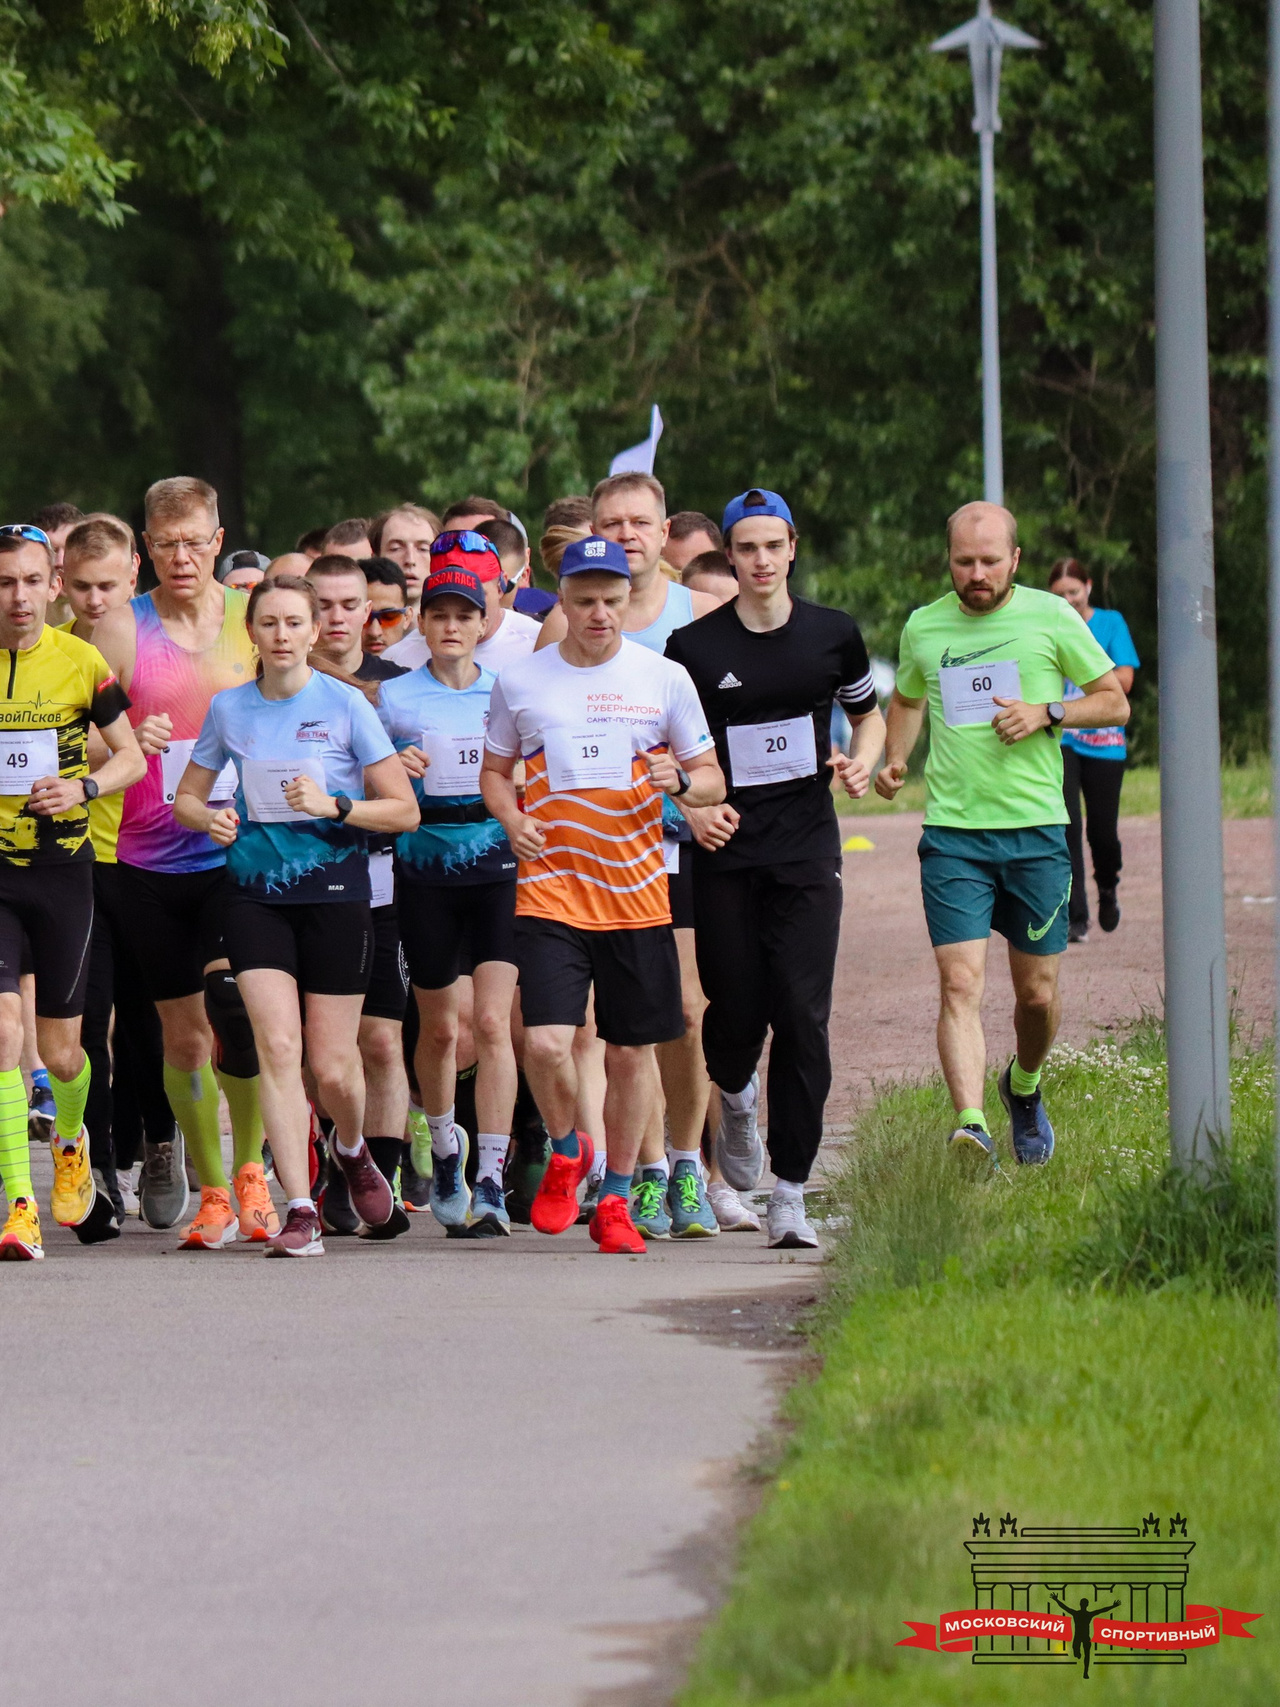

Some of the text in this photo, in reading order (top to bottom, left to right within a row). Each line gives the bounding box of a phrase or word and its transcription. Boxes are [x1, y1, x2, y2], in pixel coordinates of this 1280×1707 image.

[454, 571, 477, 590] RACE
[972, 676, 992, 692] 60
[586, 693, 624, 702] КУБОК
[586, 704, 662, 715] ГУБЕРНАТОРА
[586, 716, 659, 727] САНКТ-ПЕТЕРБУРГА
[312, 731, 329, 739] TEAM
[582, 745, 599, 758] 19
[765, 736, 787, 753] 20
[6, 753, 28, 768] 49
[458, 749, 479, 765] 18
